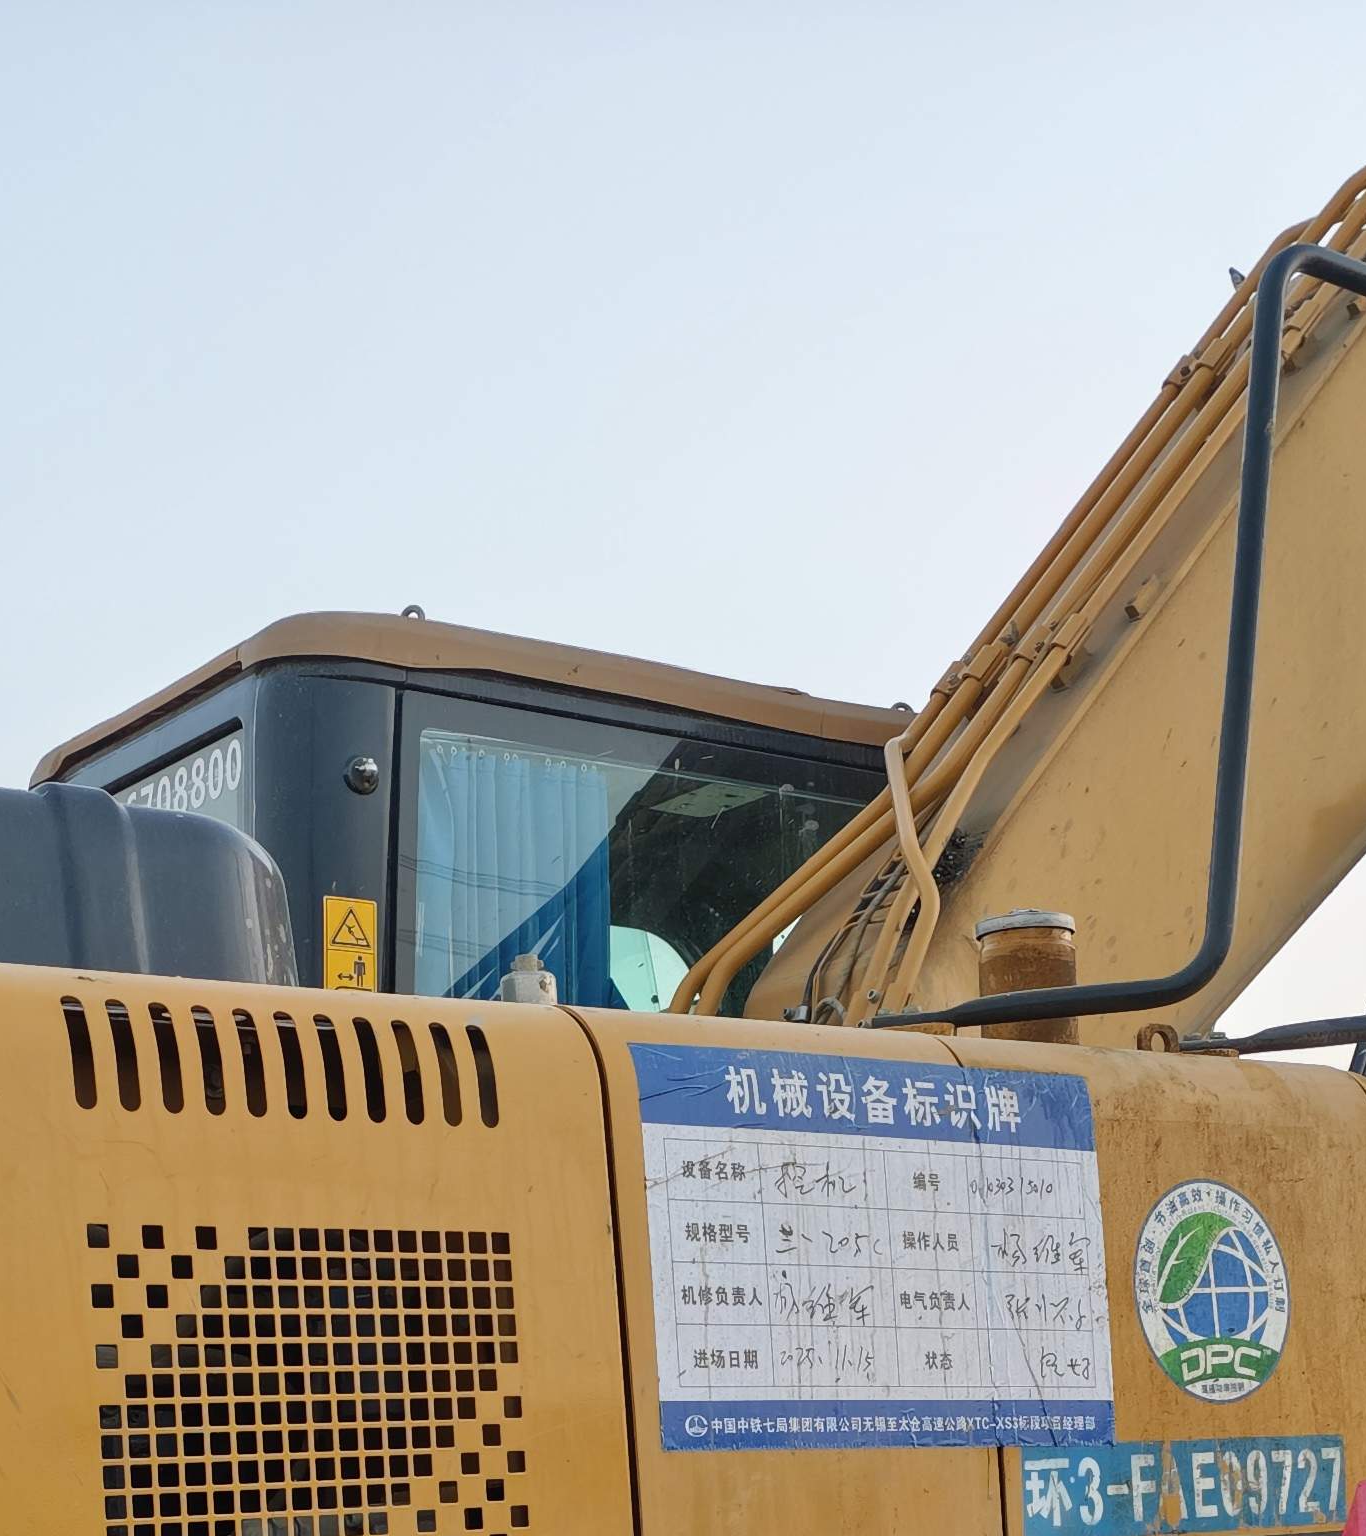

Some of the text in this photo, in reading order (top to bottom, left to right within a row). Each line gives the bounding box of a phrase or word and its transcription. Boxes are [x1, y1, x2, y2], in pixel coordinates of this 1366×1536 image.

[725, 1065, 1022, 1133] 机械设备标识牌
[681, 1160, 747, 1182] 设备名称
[912, 1171, 941, 1193] 编号
[684, 1221, 751, 1244] 规格型号
[902, 1230, 960, 1252] 操作人员
[680, 1285, 764, 1307] 机修负责人
[899, 1289, 971, 1311] 电气负责人
[692, 1349, 760, 1370] 进场日期
[924, 1350, 954, 1371] 状态
